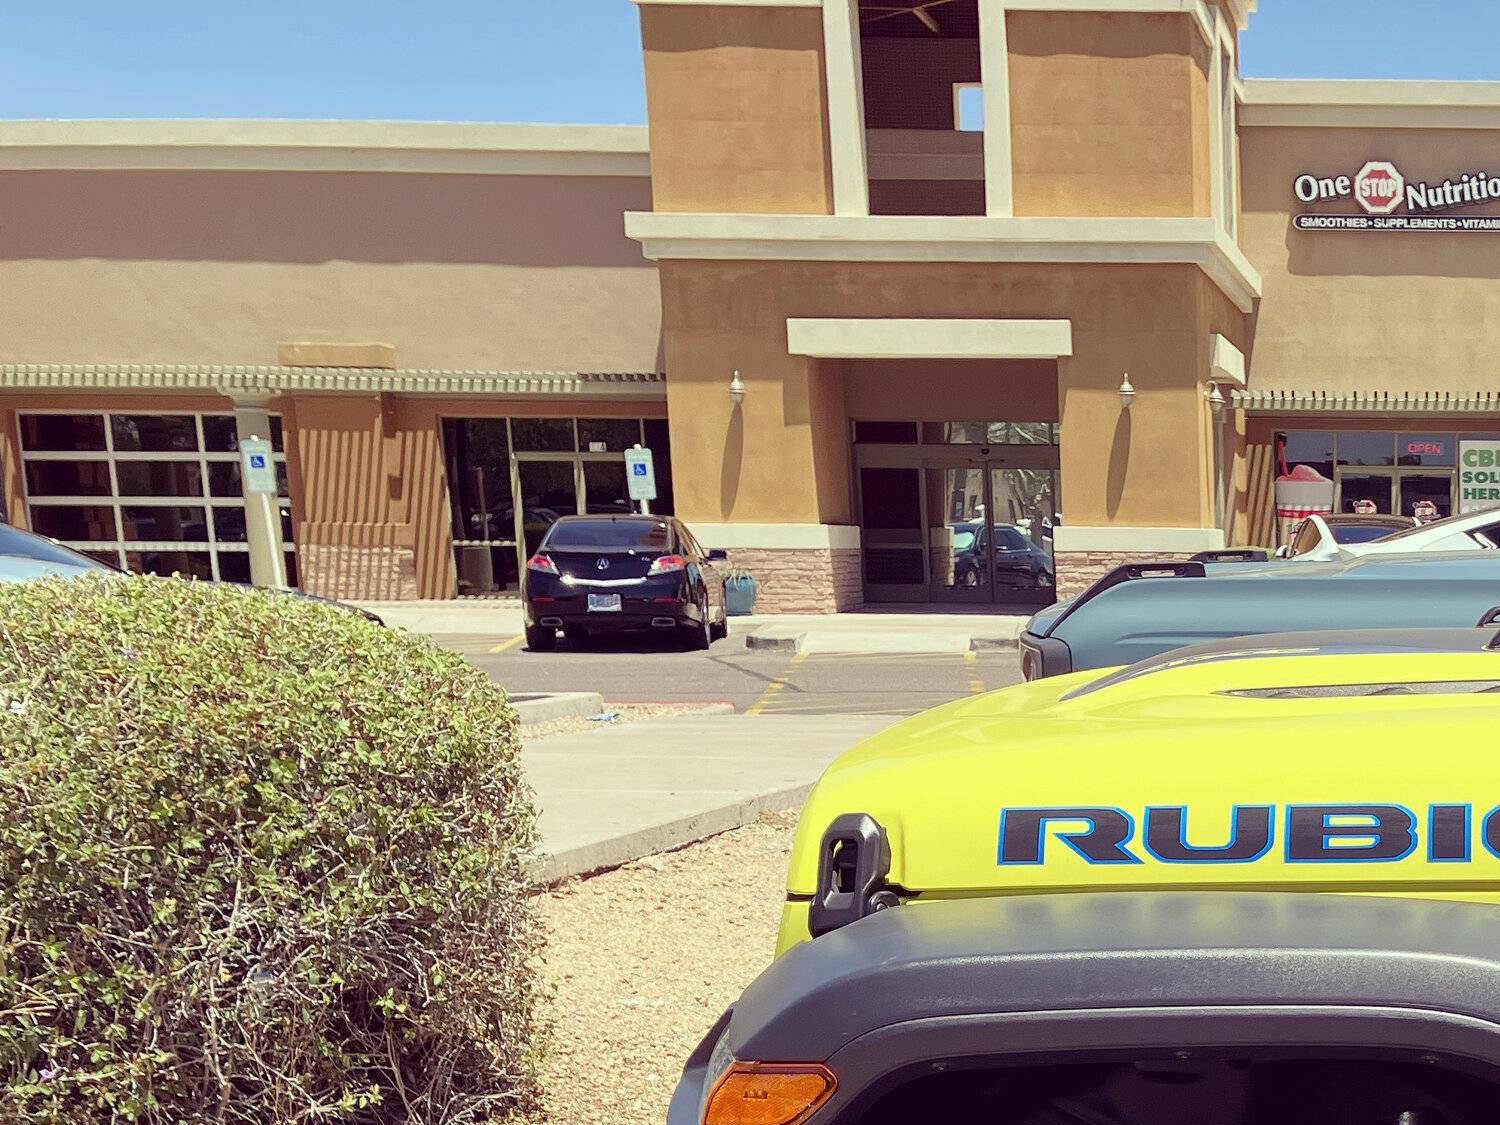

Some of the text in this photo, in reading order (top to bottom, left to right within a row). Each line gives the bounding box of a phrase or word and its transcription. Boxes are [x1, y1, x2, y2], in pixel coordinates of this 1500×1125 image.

[1295, 175, 1350, 202] One
[1360, 178, 1397, 198] STOP
[1300, 217, 1368, 228] SMOOTHIES
[1374, 218, 1457, 229] SUPPLEMENTS
[1408, 443, 1441, 454] OPEN
